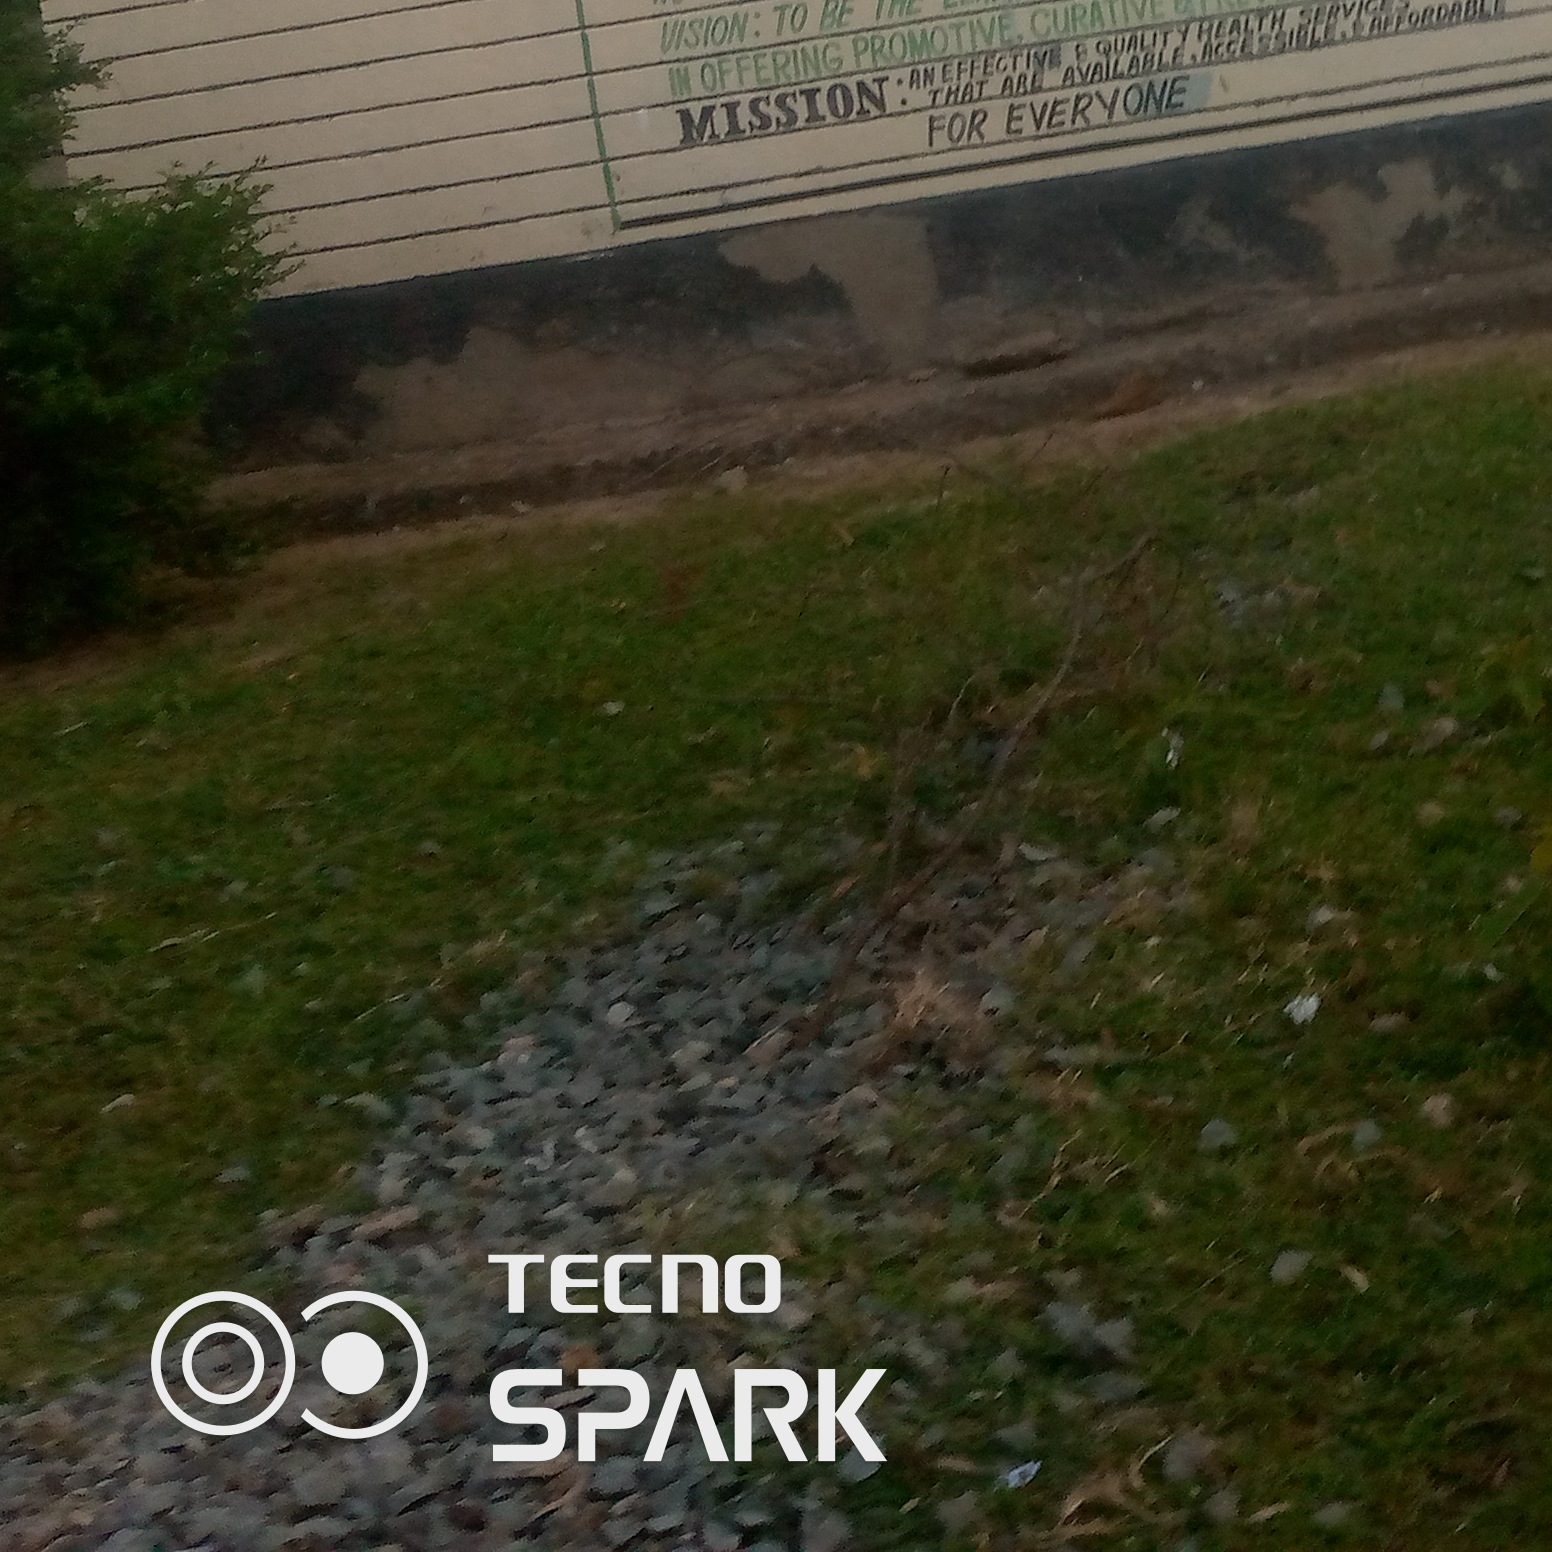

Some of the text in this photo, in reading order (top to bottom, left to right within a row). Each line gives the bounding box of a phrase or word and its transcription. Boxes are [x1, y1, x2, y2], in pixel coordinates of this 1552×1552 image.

[660, 10, 762, 54] VISION:
[773, 3, 808, 37] TO
[668, 66, 692, 99] IN
[700, 47, 844, 93] OFFERING
[909, 66, 935, 90] AN
[1095, 21, 1188, 55] QUALITY
[926, 74, 1190, 147] FOR EVERYONE
[928, 80, 988, 106] THAT
